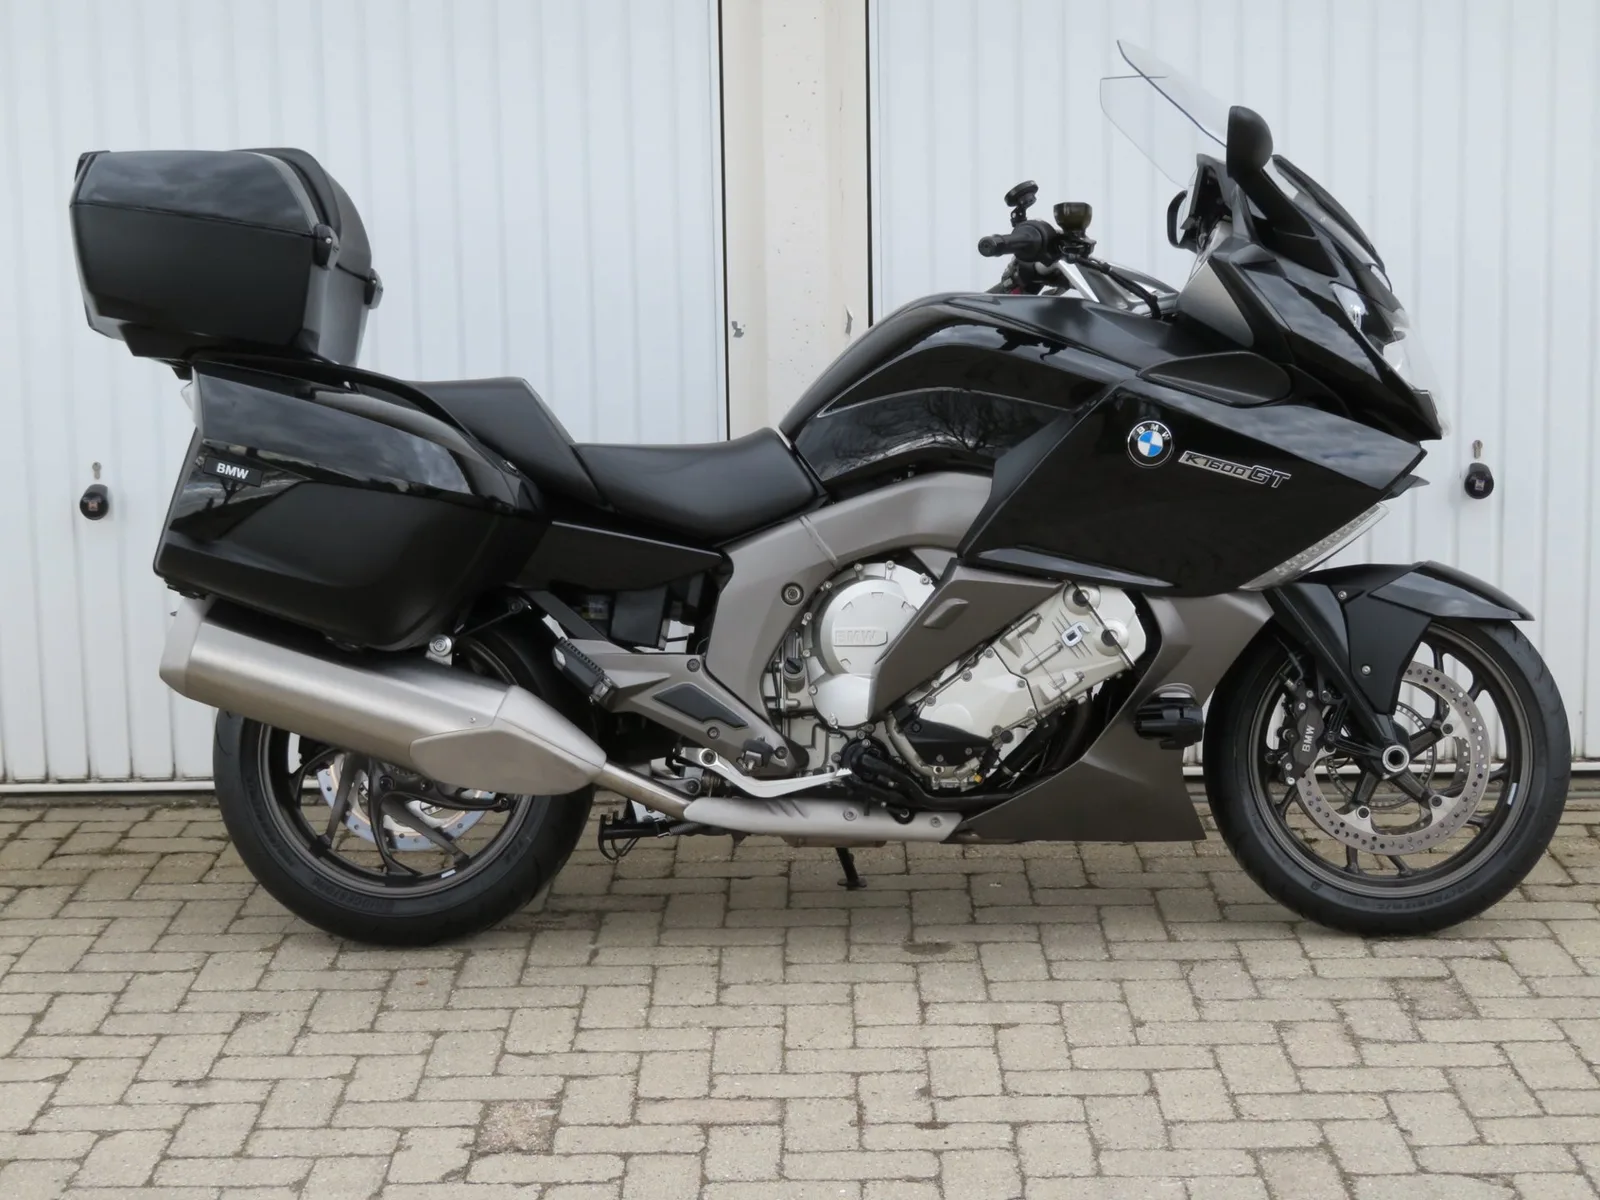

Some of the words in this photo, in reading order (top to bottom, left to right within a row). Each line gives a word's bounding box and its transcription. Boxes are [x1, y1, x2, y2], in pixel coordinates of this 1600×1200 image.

[1136, 423, 1170, 440] BMW
[216, 462, 249, 480] BMW
[1301, 724, 1315, 753] BMW
